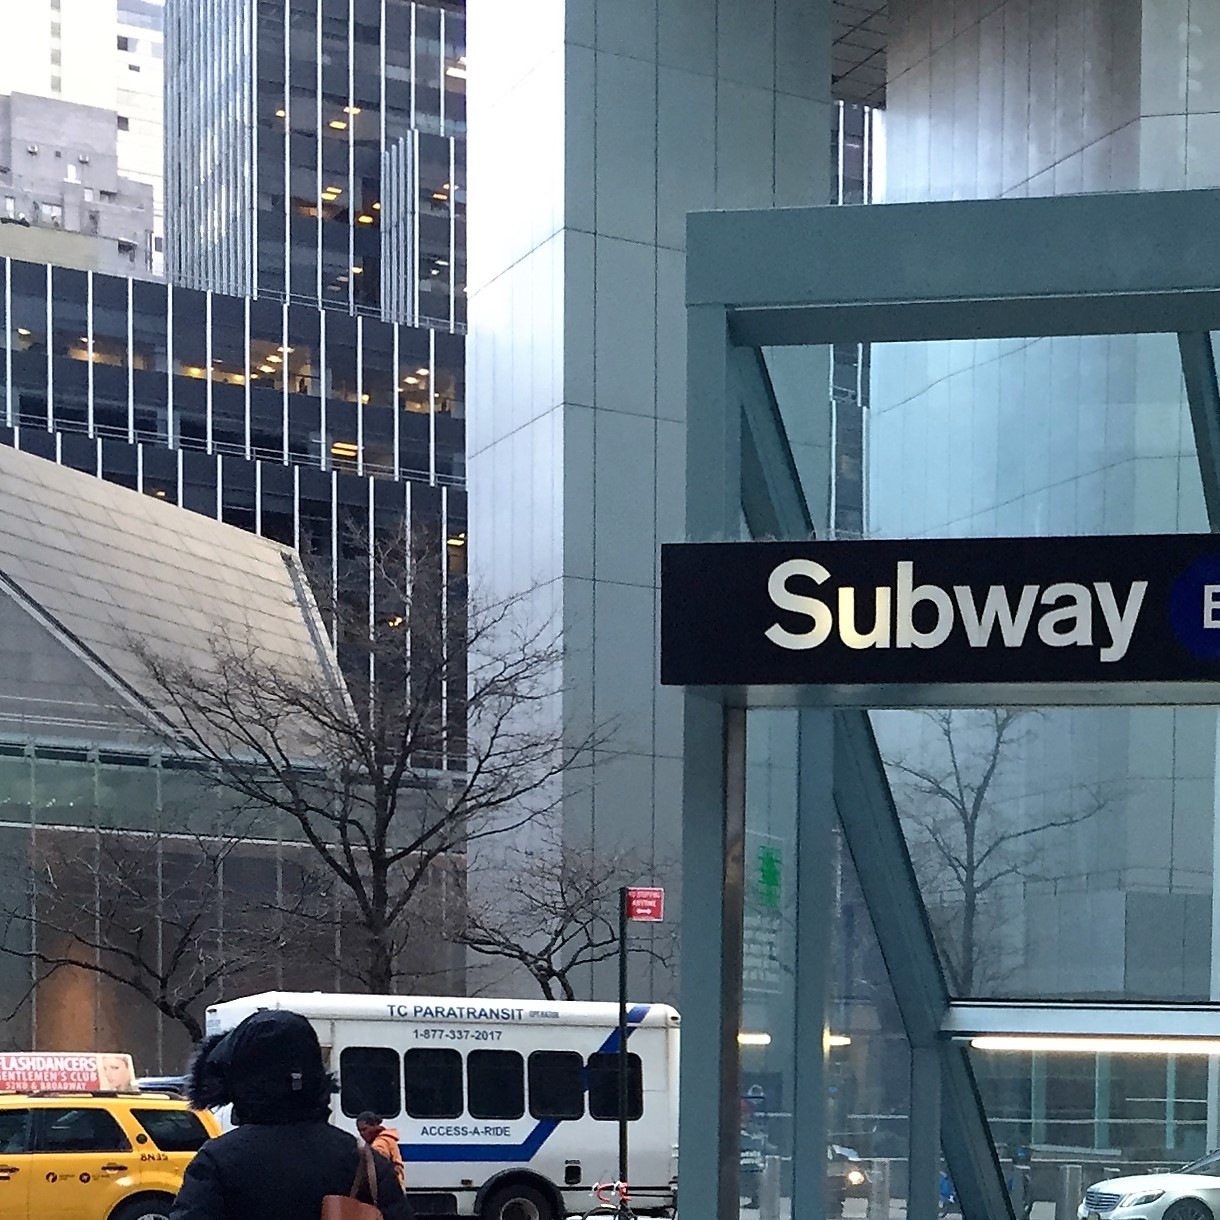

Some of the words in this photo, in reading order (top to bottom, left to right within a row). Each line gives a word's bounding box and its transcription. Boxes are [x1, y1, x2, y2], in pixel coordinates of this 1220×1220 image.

[764, 558, 1149, 662] Subway
[387, 1004, 408, 1017] TC
[413, 1005, 524, 1021] PARATRANSIT
[412, 1029, 503, 1041] 1-877-337-2017
[0, 1071, 67, 1082] ENTLEMEN'S
[70, 1071, 97, 1082] CLUB
[421, 1126, 511, 1137] ACCESS-A-RIDE
